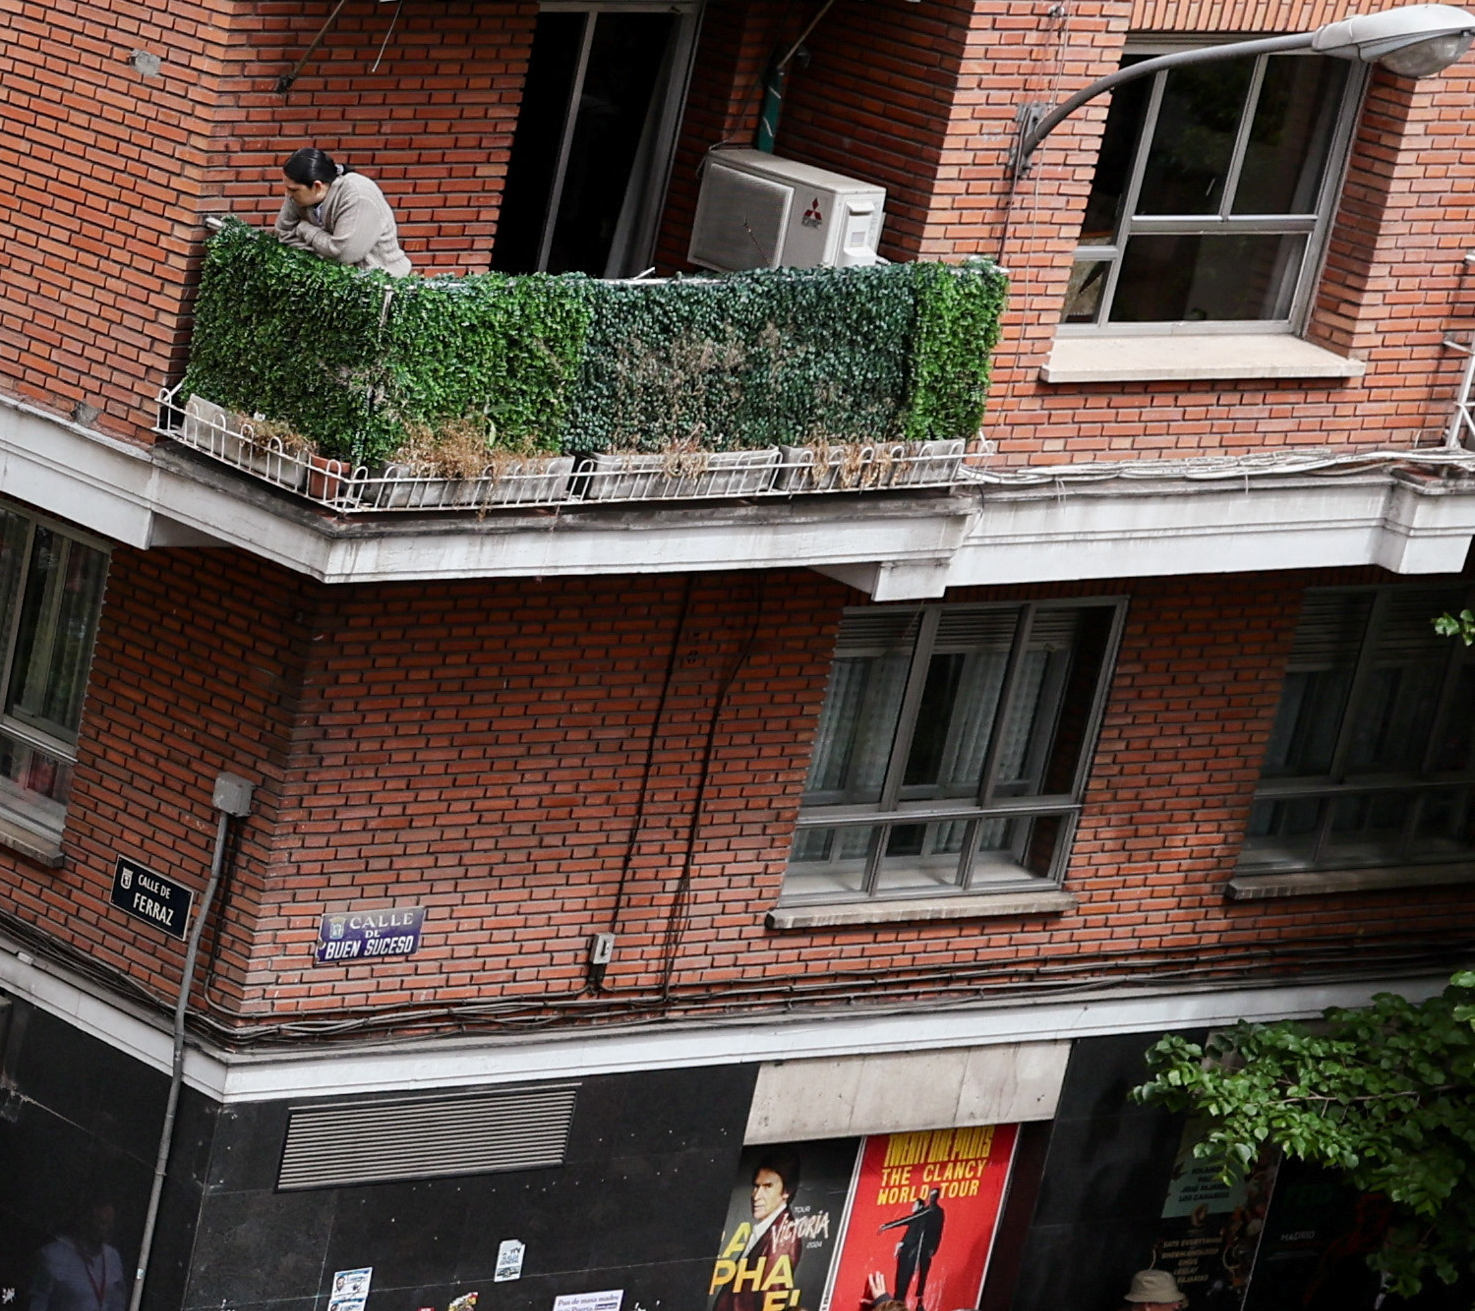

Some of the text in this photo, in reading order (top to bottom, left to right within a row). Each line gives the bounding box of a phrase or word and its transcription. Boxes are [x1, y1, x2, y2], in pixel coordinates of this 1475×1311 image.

[138, 874, 172, 900] CALLE DE
[133, 892, 175, 927] FERRAZ
[349, 912, 414, 930] CALLE
[364, 929, 381, 939] DE
[324, 935, 414, 960] BUEN SUCESO
[881, 1160, 986, 1187] THE CLANCY
[877, 1179, 980, 1206] WORLD TOUR
[794, 1205, 811, 1214] TOUR
[709, 1254, 795, 1296] PHA
[558, 1298, 571, 1307] Pan
